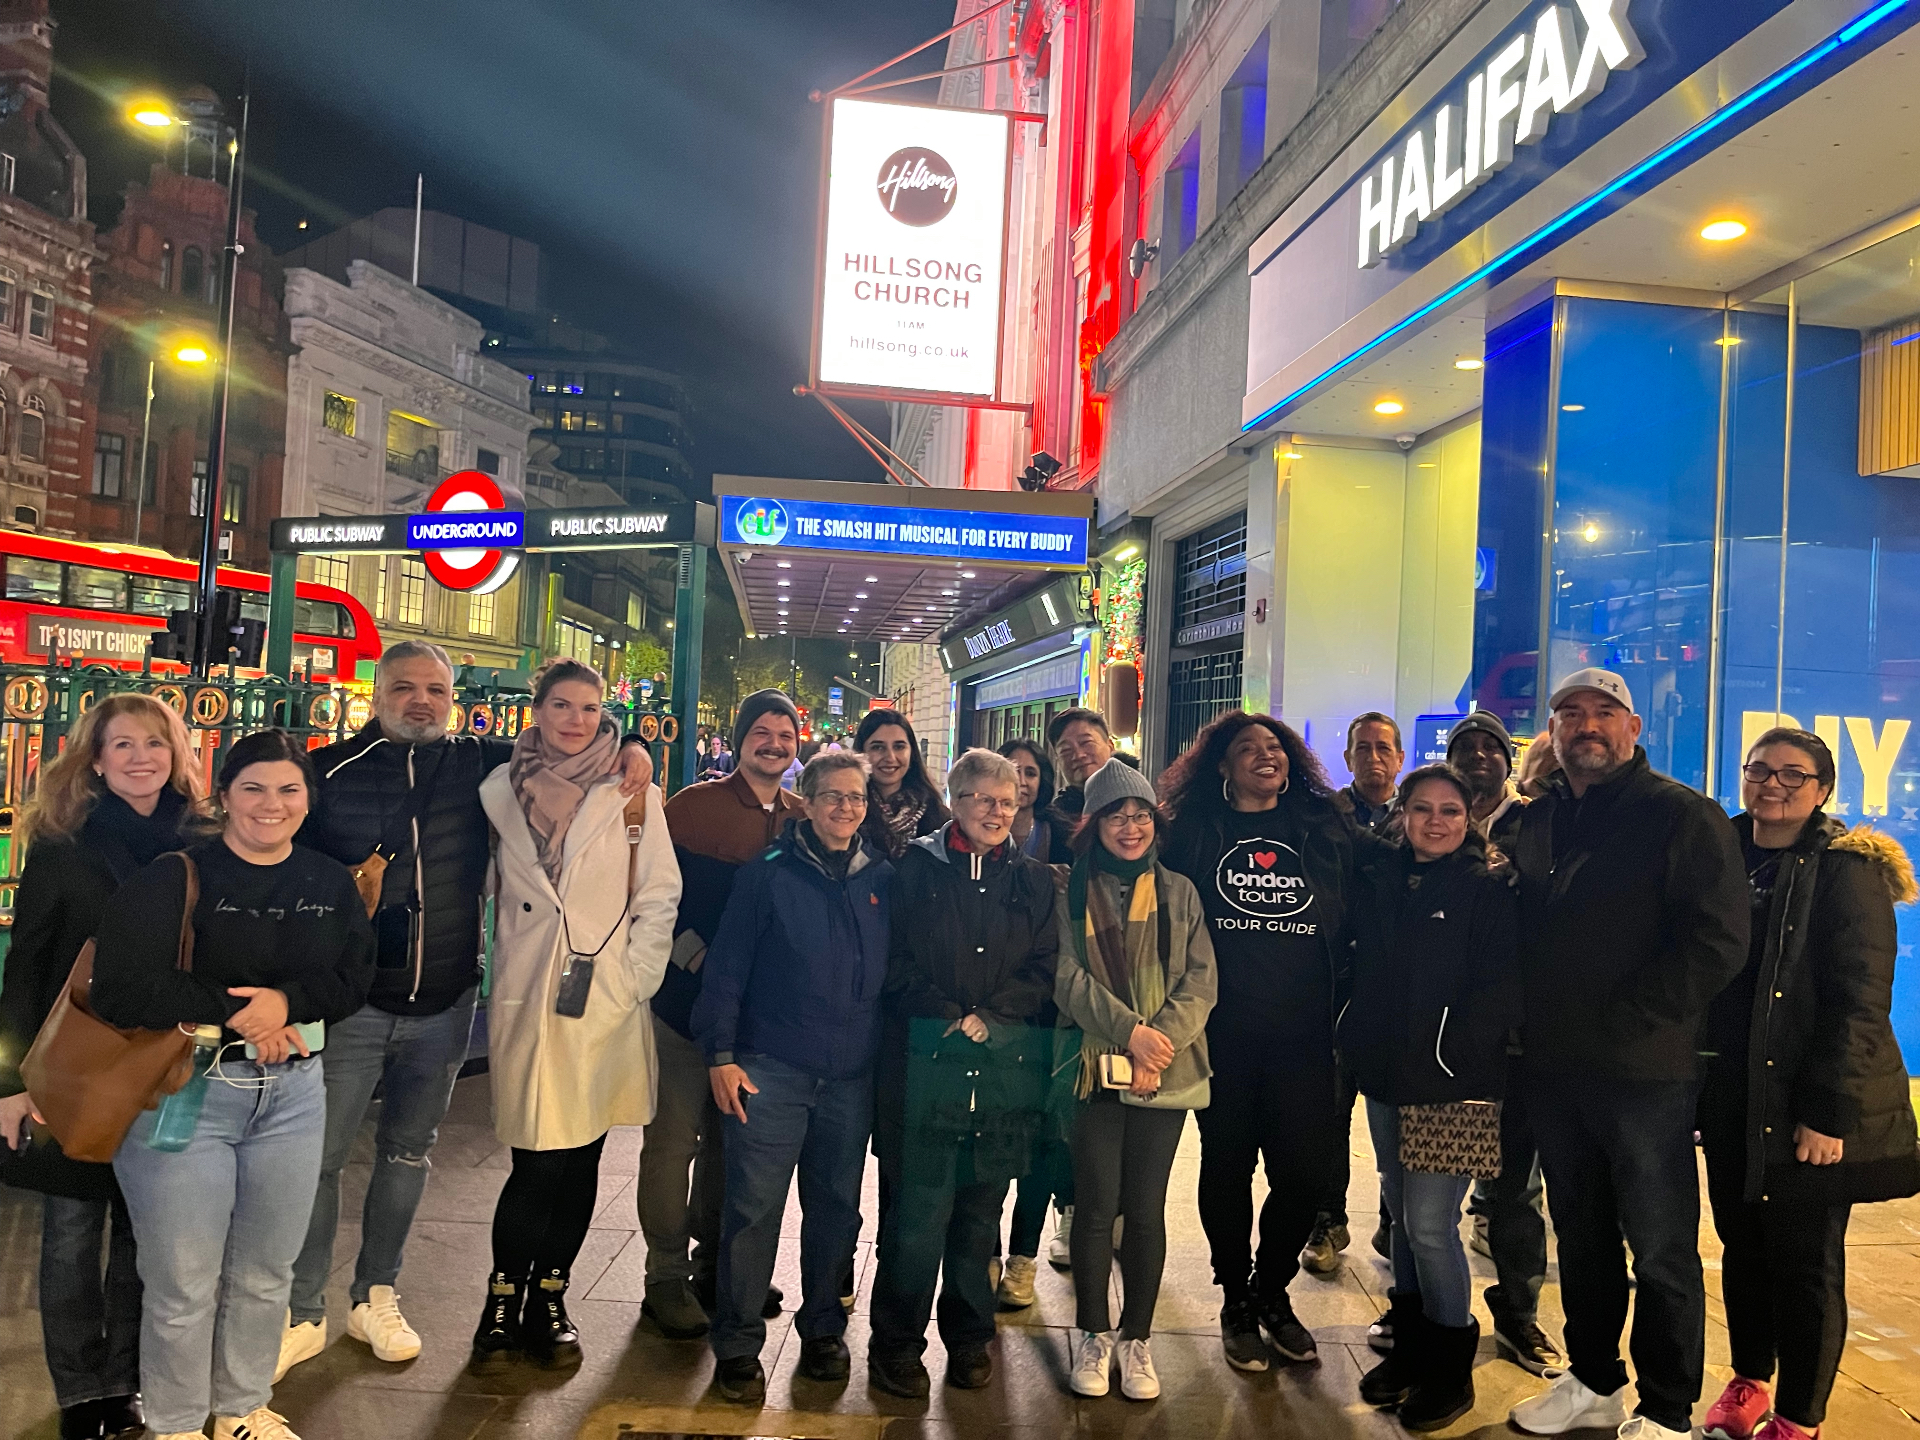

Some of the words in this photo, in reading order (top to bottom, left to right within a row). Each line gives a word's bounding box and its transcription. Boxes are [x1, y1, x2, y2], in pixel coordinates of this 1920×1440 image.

[1358, 0, 1640, 269] HALIFAX
[877, 157, 956, 212] Hillsong
[845, 252, 982, 283] HILLSONG
[854, 280, 970, 309] CHURCH
[897, 320, 925, 330] 11AM
[850, 335, 969, 358] hillsong.co.uk
[413, 522, 517, 540] UNDERGROUND
[550, 519, 602, 536] PUBLIC
[605, 515, 668, 534] SUBWAY
[743, 508, 780, 536] elf
[290, 528, 333, 543] PUBLIC
[334, 526, 384, 542] SUBWAY
[796, 517, 821, 536] THE
[823, 519, 873, 540] SMASH
[875, 522, 898, 541] HIT
[900, 524, 959, 545] MUSICAL
[962, 528, 986, 547] FOR
[989, 530, 1029, 549] EVERY
[1030, 532, 1073, 552] BUDDY
[39, 625, 66, 648] THS
[68, 628, 104, 650] ISN'T
[106, 632, 151, 654] CHICK
[1227, 869, 1305, 888] london
[1239, 888, 1297, 904] tours
[1215, 918, 1260, 930] TOUR
[1266, 921, 1316, 935] GUIDE
[1450, 1105, 1469, 1116] MK
[1417, 1114, 1435, 1125] MK
[1439, 1117, 1457, 1128] MK
[1406, 1124, 1424, 1137] MK
[1427, 1127, 1445, 1139] MK
[1449, 1129, 1468, 1141] MK
[1470, 1131, 1489, 1142] MK
[1415, 1138, 1433, 1150] MK
[1436, 1141, 1455, 1152] MK
[1458, 1142, 1477, 1154] MK
[1479, 1144, 1497, 1155] MK
[1403, 1149, 1421, 1161] MK
[1425, 1152, 1443, 1164] MK
[1446, 1154, 1465, 1166] MK
[1468, 1156, 1487, 1167] MK
[1456, 1167, 1474, 1178] MK
[1477, 1169, 1495, 1179] MK
